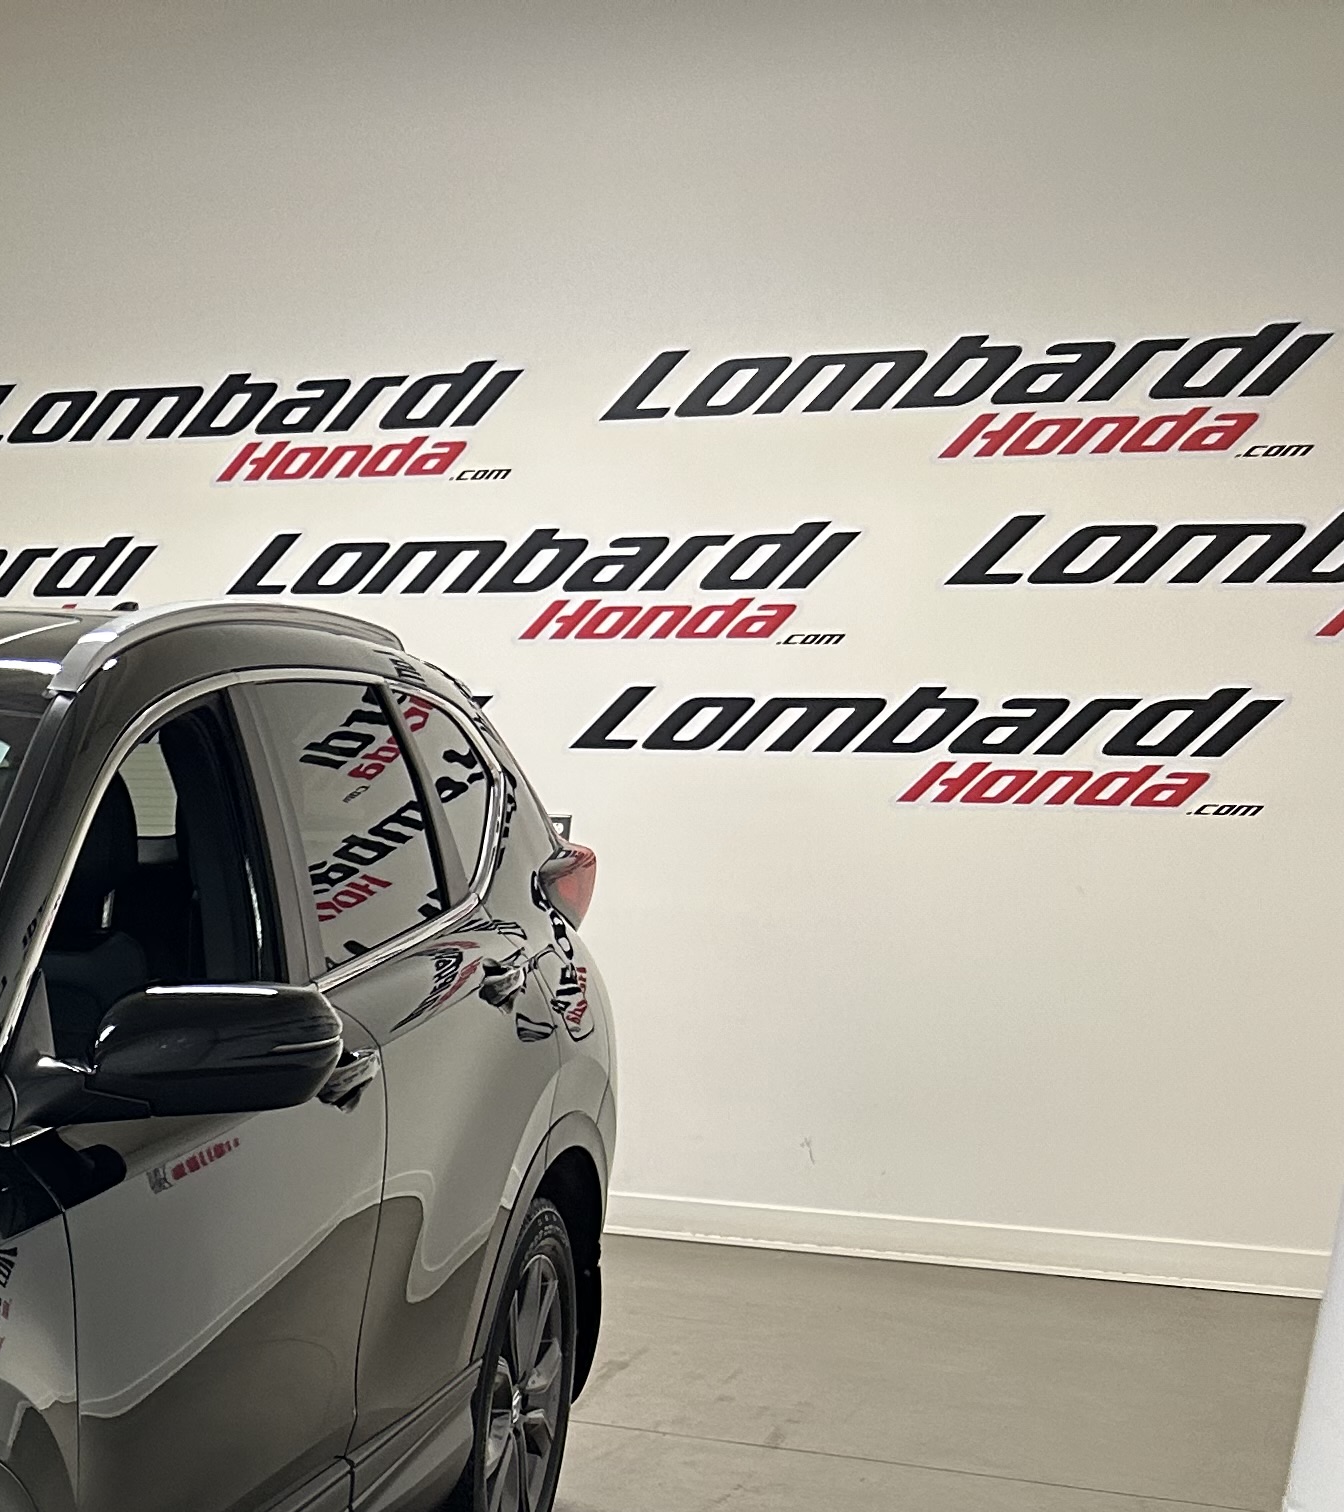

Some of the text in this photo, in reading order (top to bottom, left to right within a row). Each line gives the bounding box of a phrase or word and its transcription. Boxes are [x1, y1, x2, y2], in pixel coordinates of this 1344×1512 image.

[600, 322, 1334, 420] Lombardi
[941, 407, 1258, 458] Honda
[217, 436, 467, 481] Honda
[226, 521, 861, 595] Lombardi
[519, 597, 797, 639] Honda
[569, 686, 1284, 757] Lombardi
[899, 761, 1210, 807] Honda
